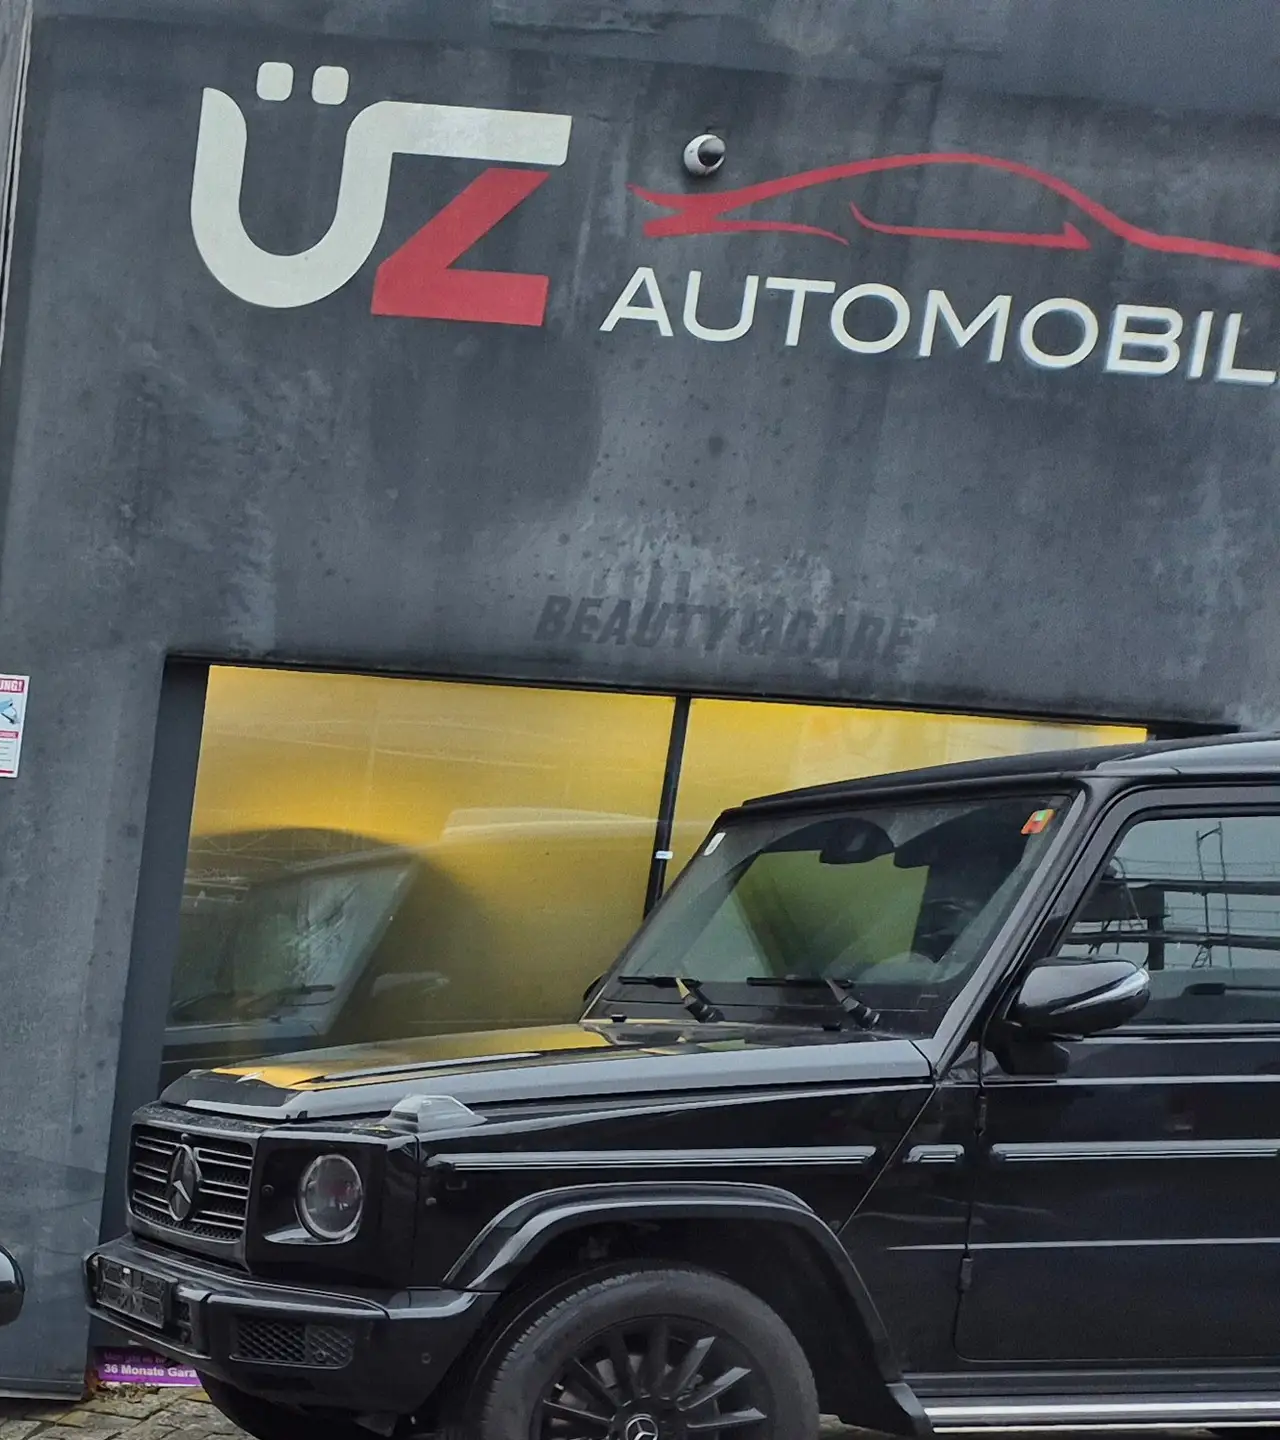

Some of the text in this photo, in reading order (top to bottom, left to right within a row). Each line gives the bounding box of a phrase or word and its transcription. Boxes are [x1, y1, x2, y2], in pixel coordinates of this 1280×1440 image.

[190, 62, 572, 328] ÜZ
[599, 265, 1278, 386] AUTOMOBIL
[535, 594, 738, 651] BEAUTY
[104, 1363, 118, 1374] 36
[121, 1364, 165, 1377] Monate
